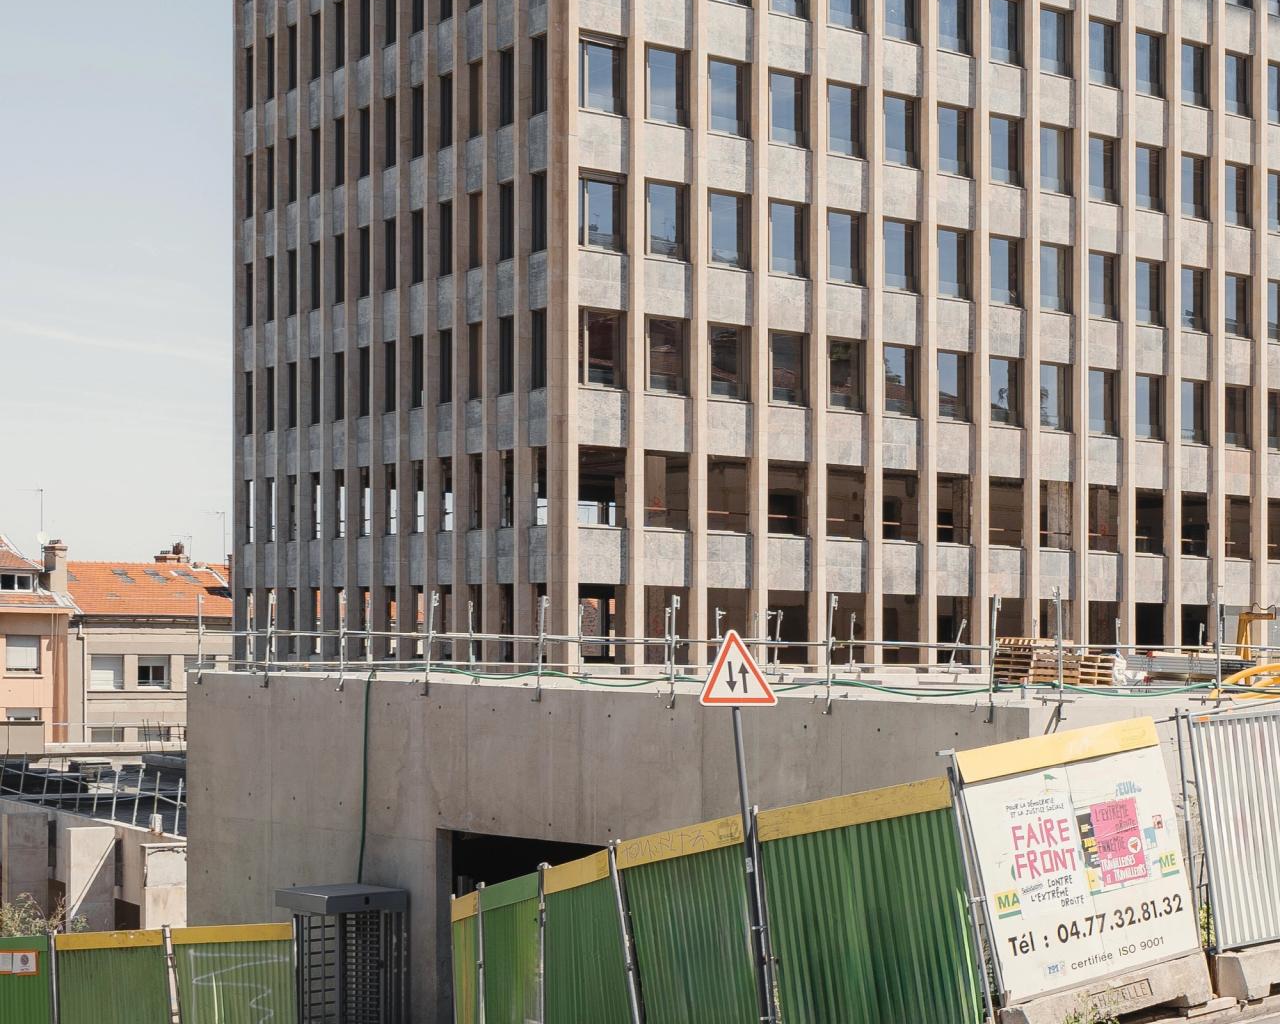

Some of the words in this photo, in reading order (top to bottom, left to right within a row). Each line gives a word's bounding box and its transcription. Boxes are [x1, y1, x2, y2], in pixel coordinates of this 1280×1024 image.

[1014, 847, 1077, 880] FRONT
[1047, 874, 1073, 887] CONTRE
[1008, 930, 1036, 957] Tél
[1057, 893, 1184, 944] 04.77.32.81.32
[1071, 952, 1113, 971] certifiée
[1118, 943, 1137, 957] ISO
[1139, 936, 1165, 951] 9001
